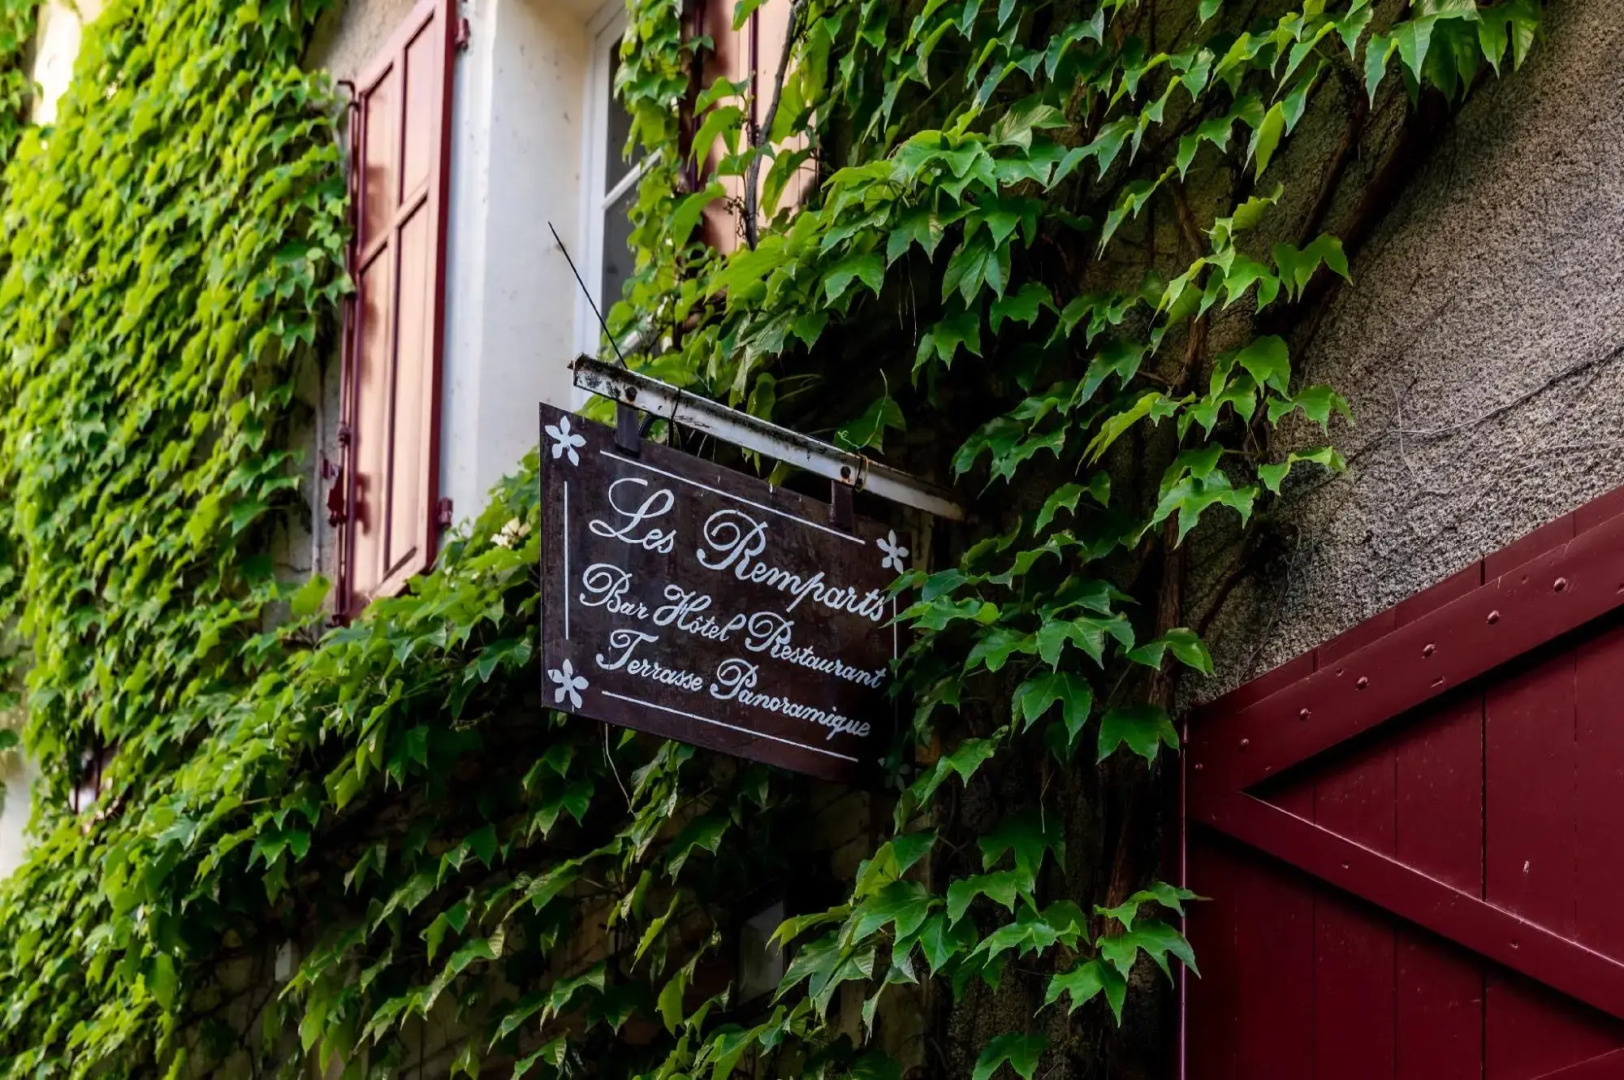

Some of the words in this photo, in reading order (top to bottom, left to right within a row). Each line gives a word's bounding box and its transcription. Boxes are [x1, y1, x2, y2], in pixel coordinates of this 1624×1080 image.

[589, 478, 677, 554] Les
[696, 509, 885, 622] Remparts
[580, 563, 650, 619] Bar
[653, 584, 747, 642] Hôtel
[745, 611, 887, 689] Restaurant
[596, 629, 704, 693] Terrasse
[710, 658, 871, 740] Panoramique
